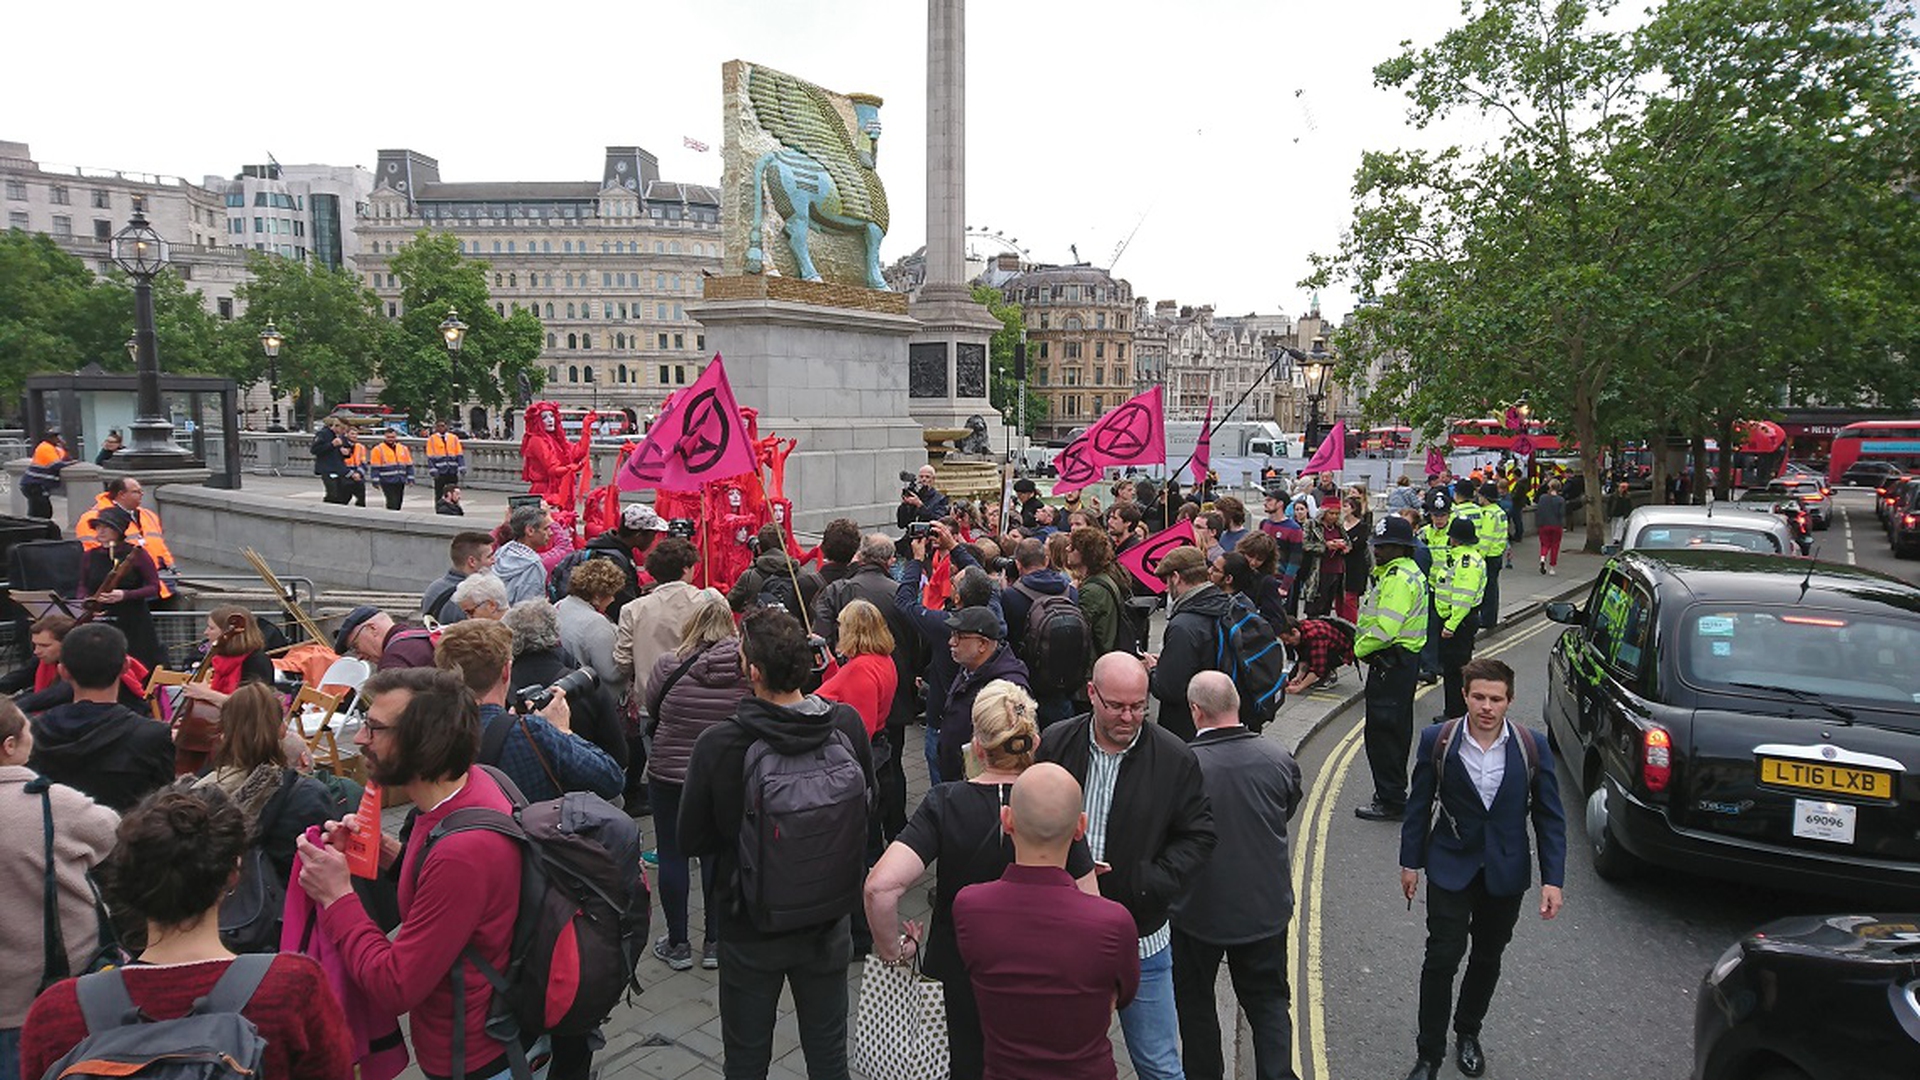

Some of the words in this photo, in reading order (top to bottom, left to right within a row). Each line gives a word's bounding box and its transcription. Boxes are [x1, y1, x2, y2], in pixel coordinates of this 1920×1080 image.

[1776, 763, 1824, 785] LT16
[1831, 771, 1875, 791] LXB
[1806, 815, 1844, 828] 69096
